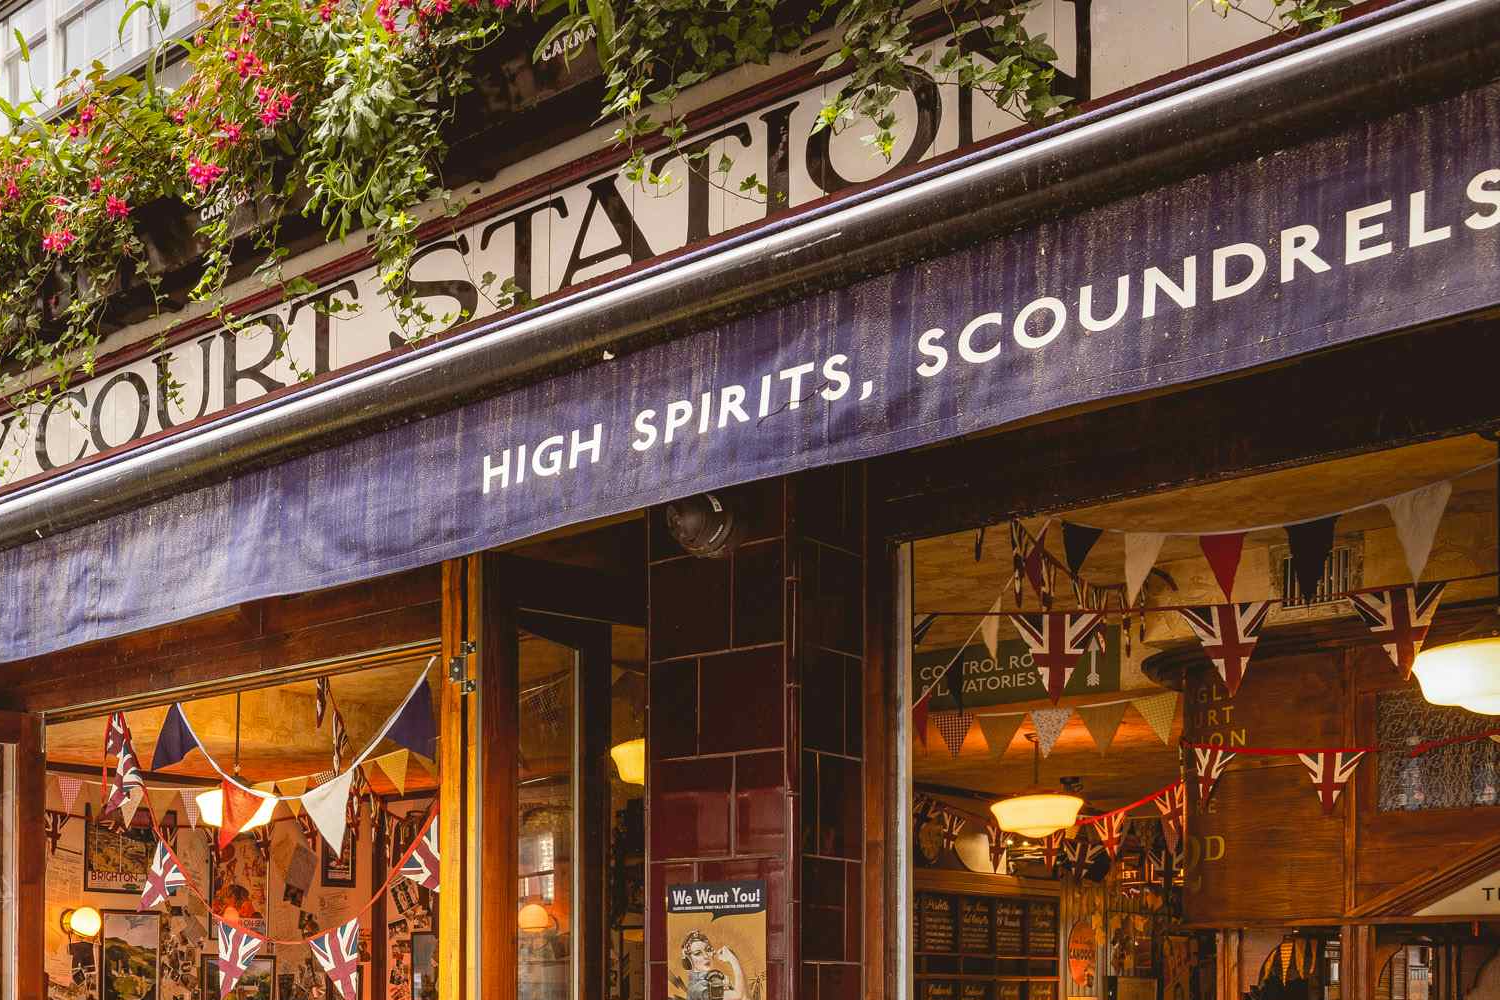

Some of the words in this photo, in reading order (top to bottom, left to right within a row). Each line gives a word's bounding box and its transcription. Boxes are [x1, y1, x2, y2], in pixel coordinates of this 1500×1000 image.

[35, 279, 360, 471] COURT
[388, 0, 1093, 348] STATION
[483, 423, 603, 494] HIGH
[631, 353, 874, 452] SPIRITS,
[915, 168, 1500, 378] SCOUNDRELS
[920, 657, 1004, 681] COTROL
[672, 889, 693, 905] We
[695, 888, 729, 904] Want
[731, 887, 760, 903] You!
